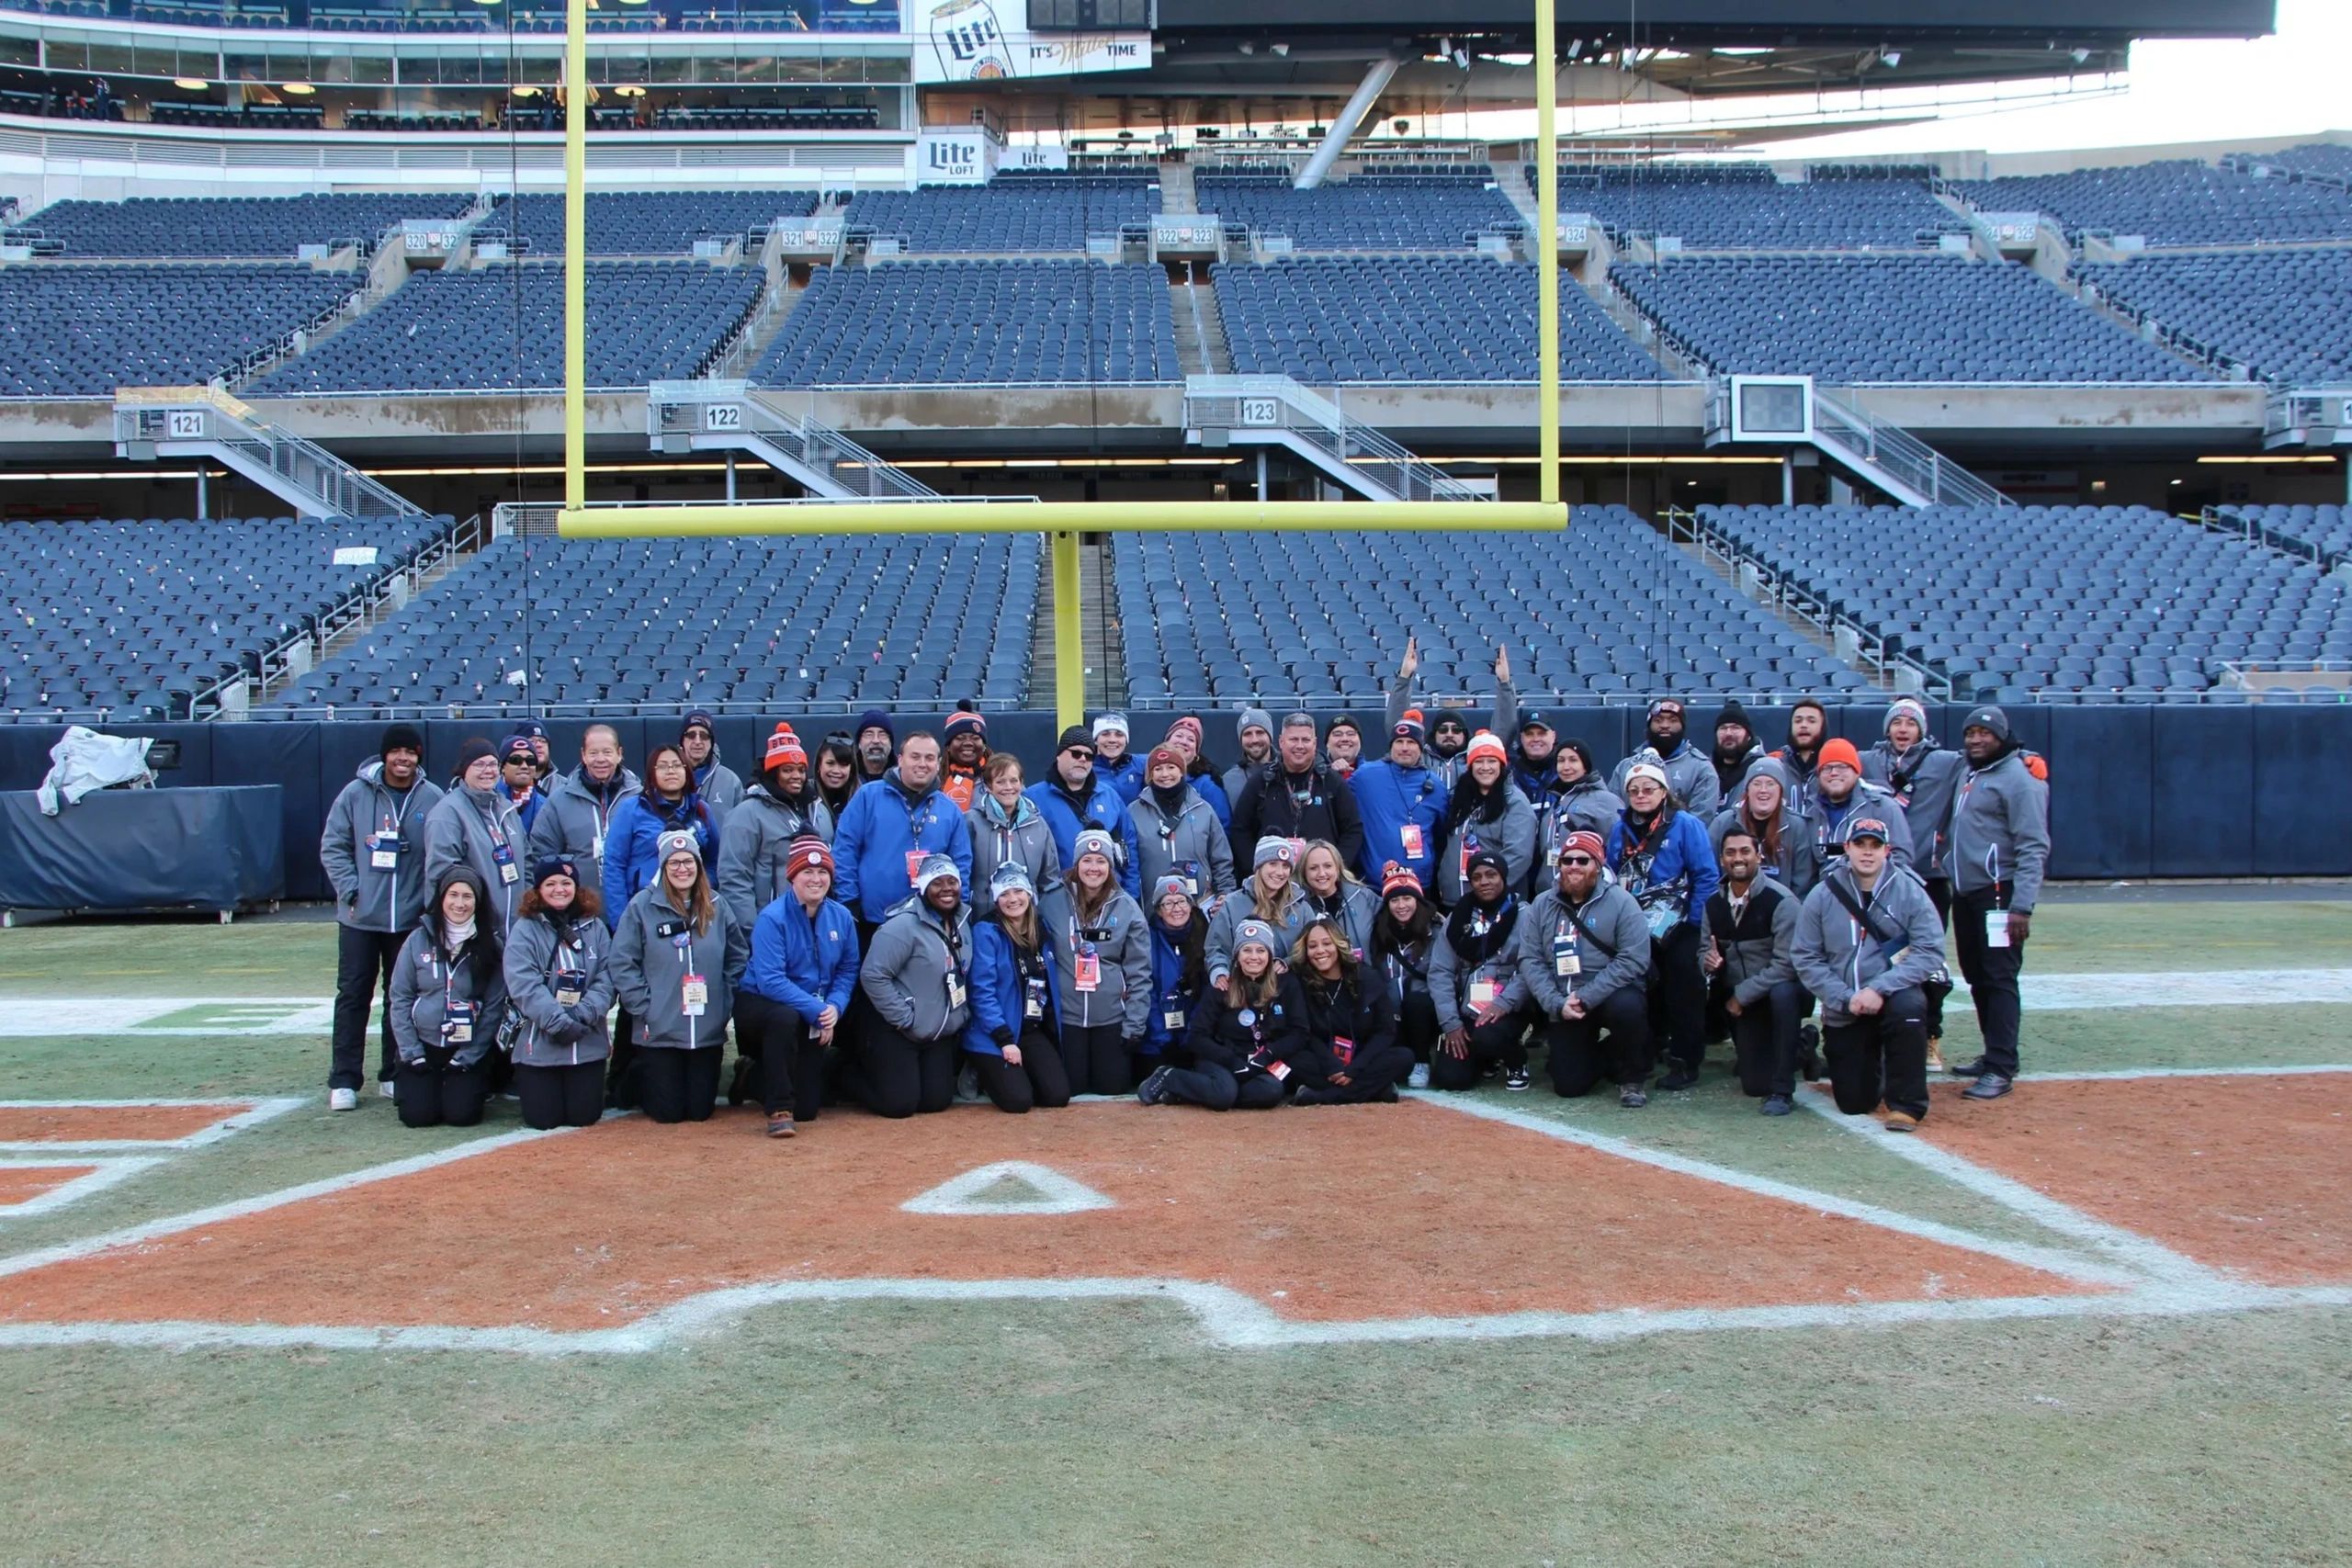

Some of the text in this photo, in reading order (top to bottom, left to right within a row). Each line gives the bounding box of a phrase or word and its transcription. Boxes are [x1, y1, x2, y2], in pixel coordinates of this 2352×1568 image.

[945, 17, 995, 60] Lite
[1031, 46, 1052, 58] IT'S
[1106, 44, 1136, 57] TIME
[929, 141, 975, 169] Lite
[1022, 152, 1046, 166] Lite
[949, 165, 974, 175] LOFT
[407, 234, 425, 248] 320
[444, 234, 461, 248] 32
[785, 232, 802, 245] 321
[820, 232, 838, 244] 322
[1159, 230, 1177, 243] 322
[1194, 230, 1212, 243] 323
[708, 409, 738, 425] 122
[1245, 403, 1274, 420] 123
[175, 416, 200, 433] 121
